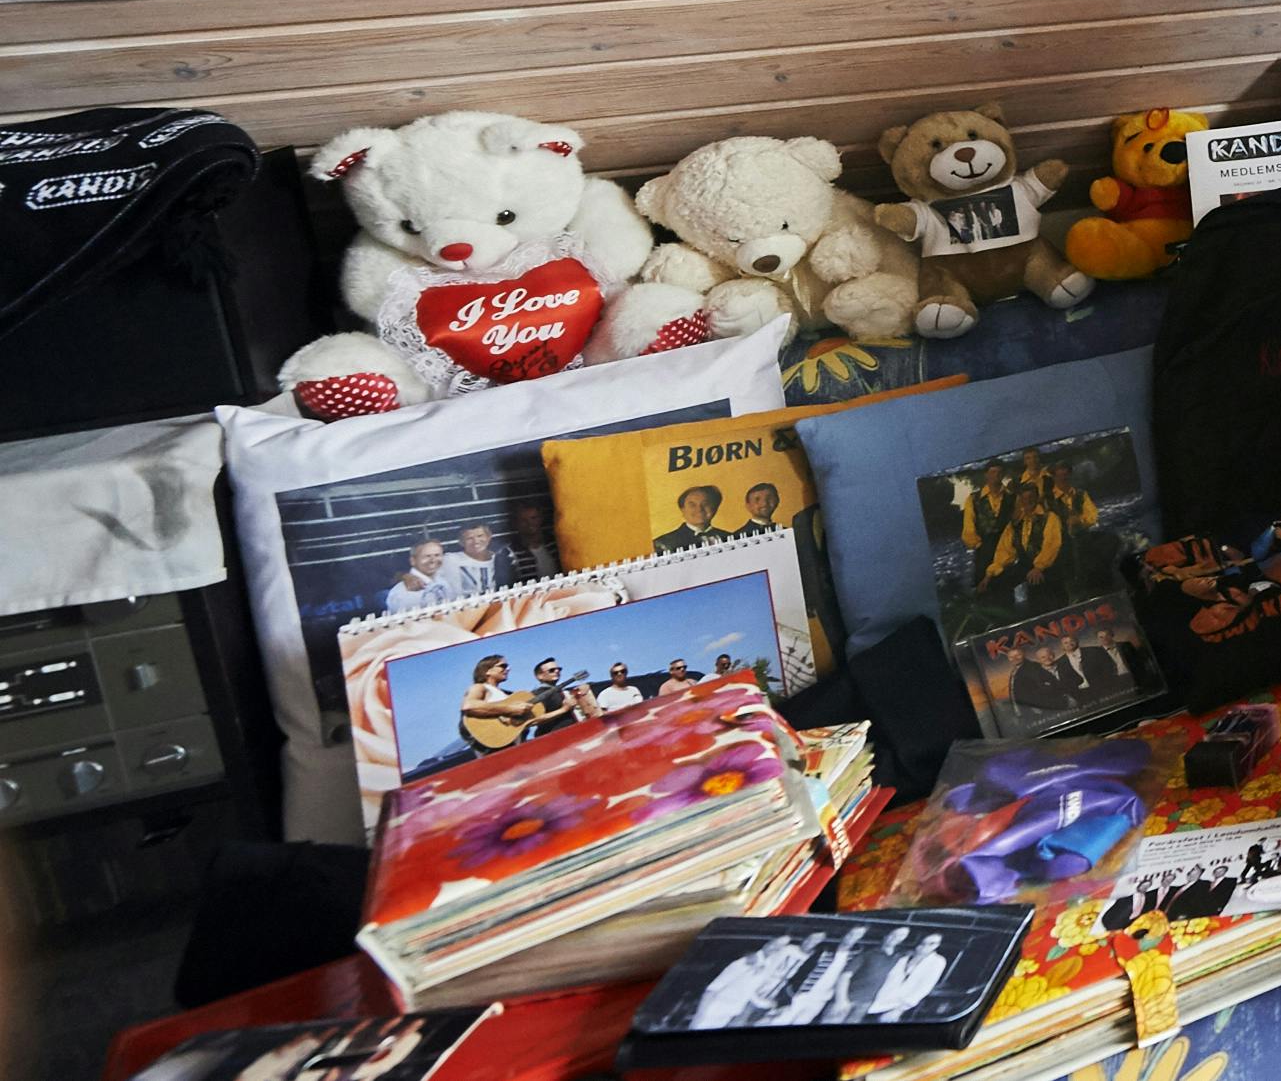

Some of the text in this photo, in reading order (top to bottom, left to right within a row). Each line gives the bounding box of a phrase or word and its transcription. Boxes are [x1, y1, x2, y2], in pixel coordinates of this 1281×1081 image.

[449, 288, 580, 332] I Love
[482, 322, 565, 355] You
[668, 438, 762, 473] BJØRN
[985, 603, 1118, 659] KANDIS
